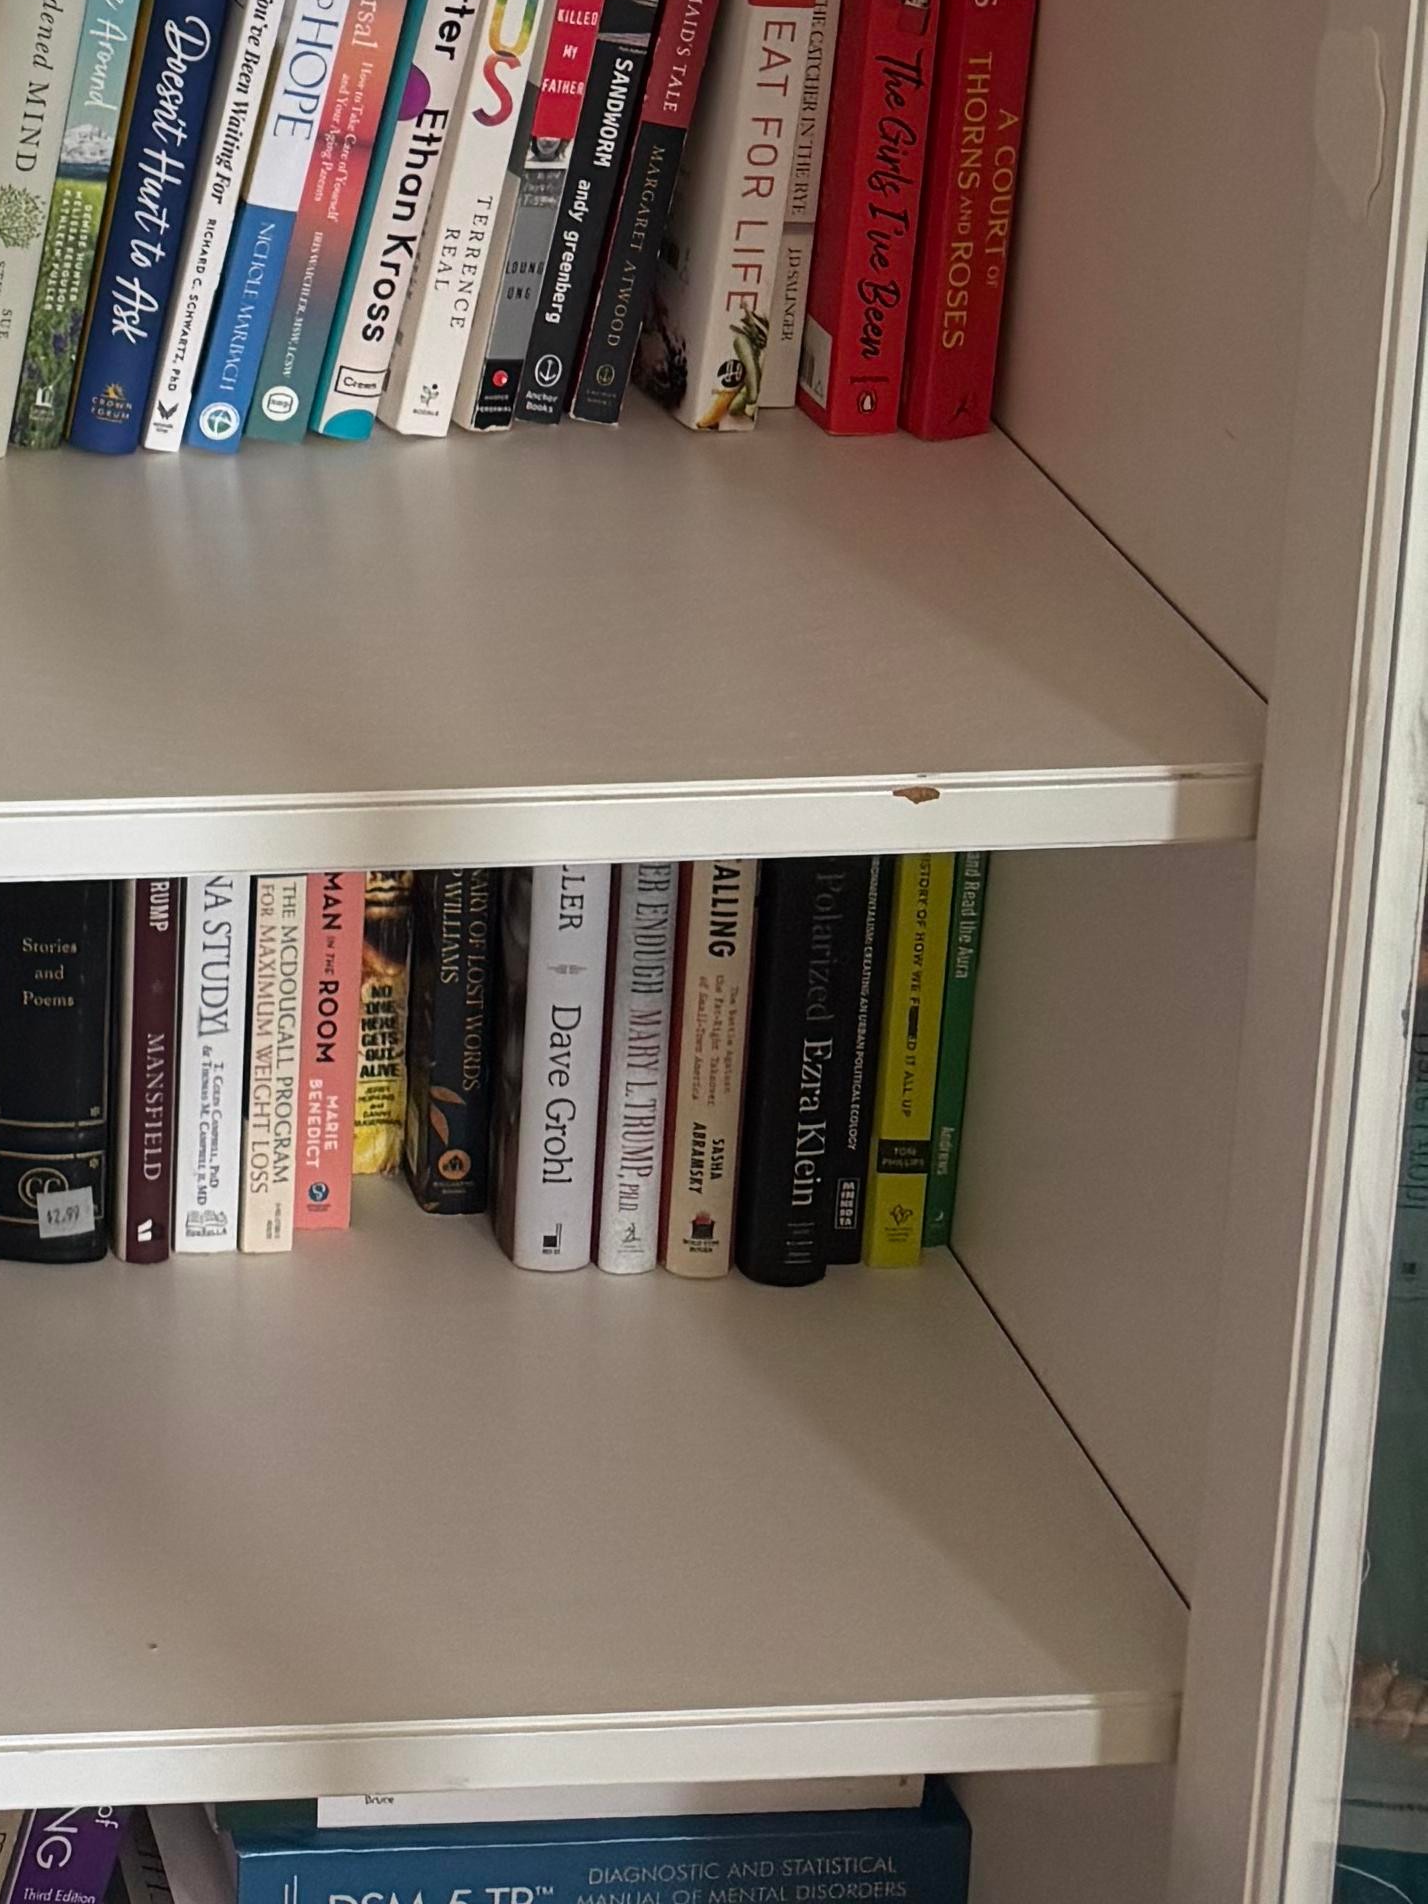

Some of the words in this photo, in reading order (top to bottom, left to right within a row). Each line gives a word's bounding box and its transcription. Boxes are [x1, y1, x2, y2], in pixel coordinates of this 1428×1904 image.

[557, 8, 598, 26] KILLED
[564, 44, 578, 58] MY
[542, 78, 585, 96] FATHER
[591, 58, 634, 168] SANDWORM
[399, 109, 448, 219] Ethan
[361, 233, 414, 344] Kross
[22, 938, 76, 955] Stories
[35, 965, 64, 980] and
[22, 991, 74, 1008] Poems
[549, 1004, 582, 1089] Dave
[146, 1033, 163, 1181] MANSFIELD
[309, 1080, 324, 1168] BENEDICT
[323, 1095, 339, 1151] MARIE
[542, 1097, 576, 1186] Grohl
[587, 1862, 715, 1885] DIAGNOSTIC
[727, 1860, 773, 1880] AND
[781, 1855, 898, 1877] STATISTICAL
[24, 1887, 53, 1900] Third
